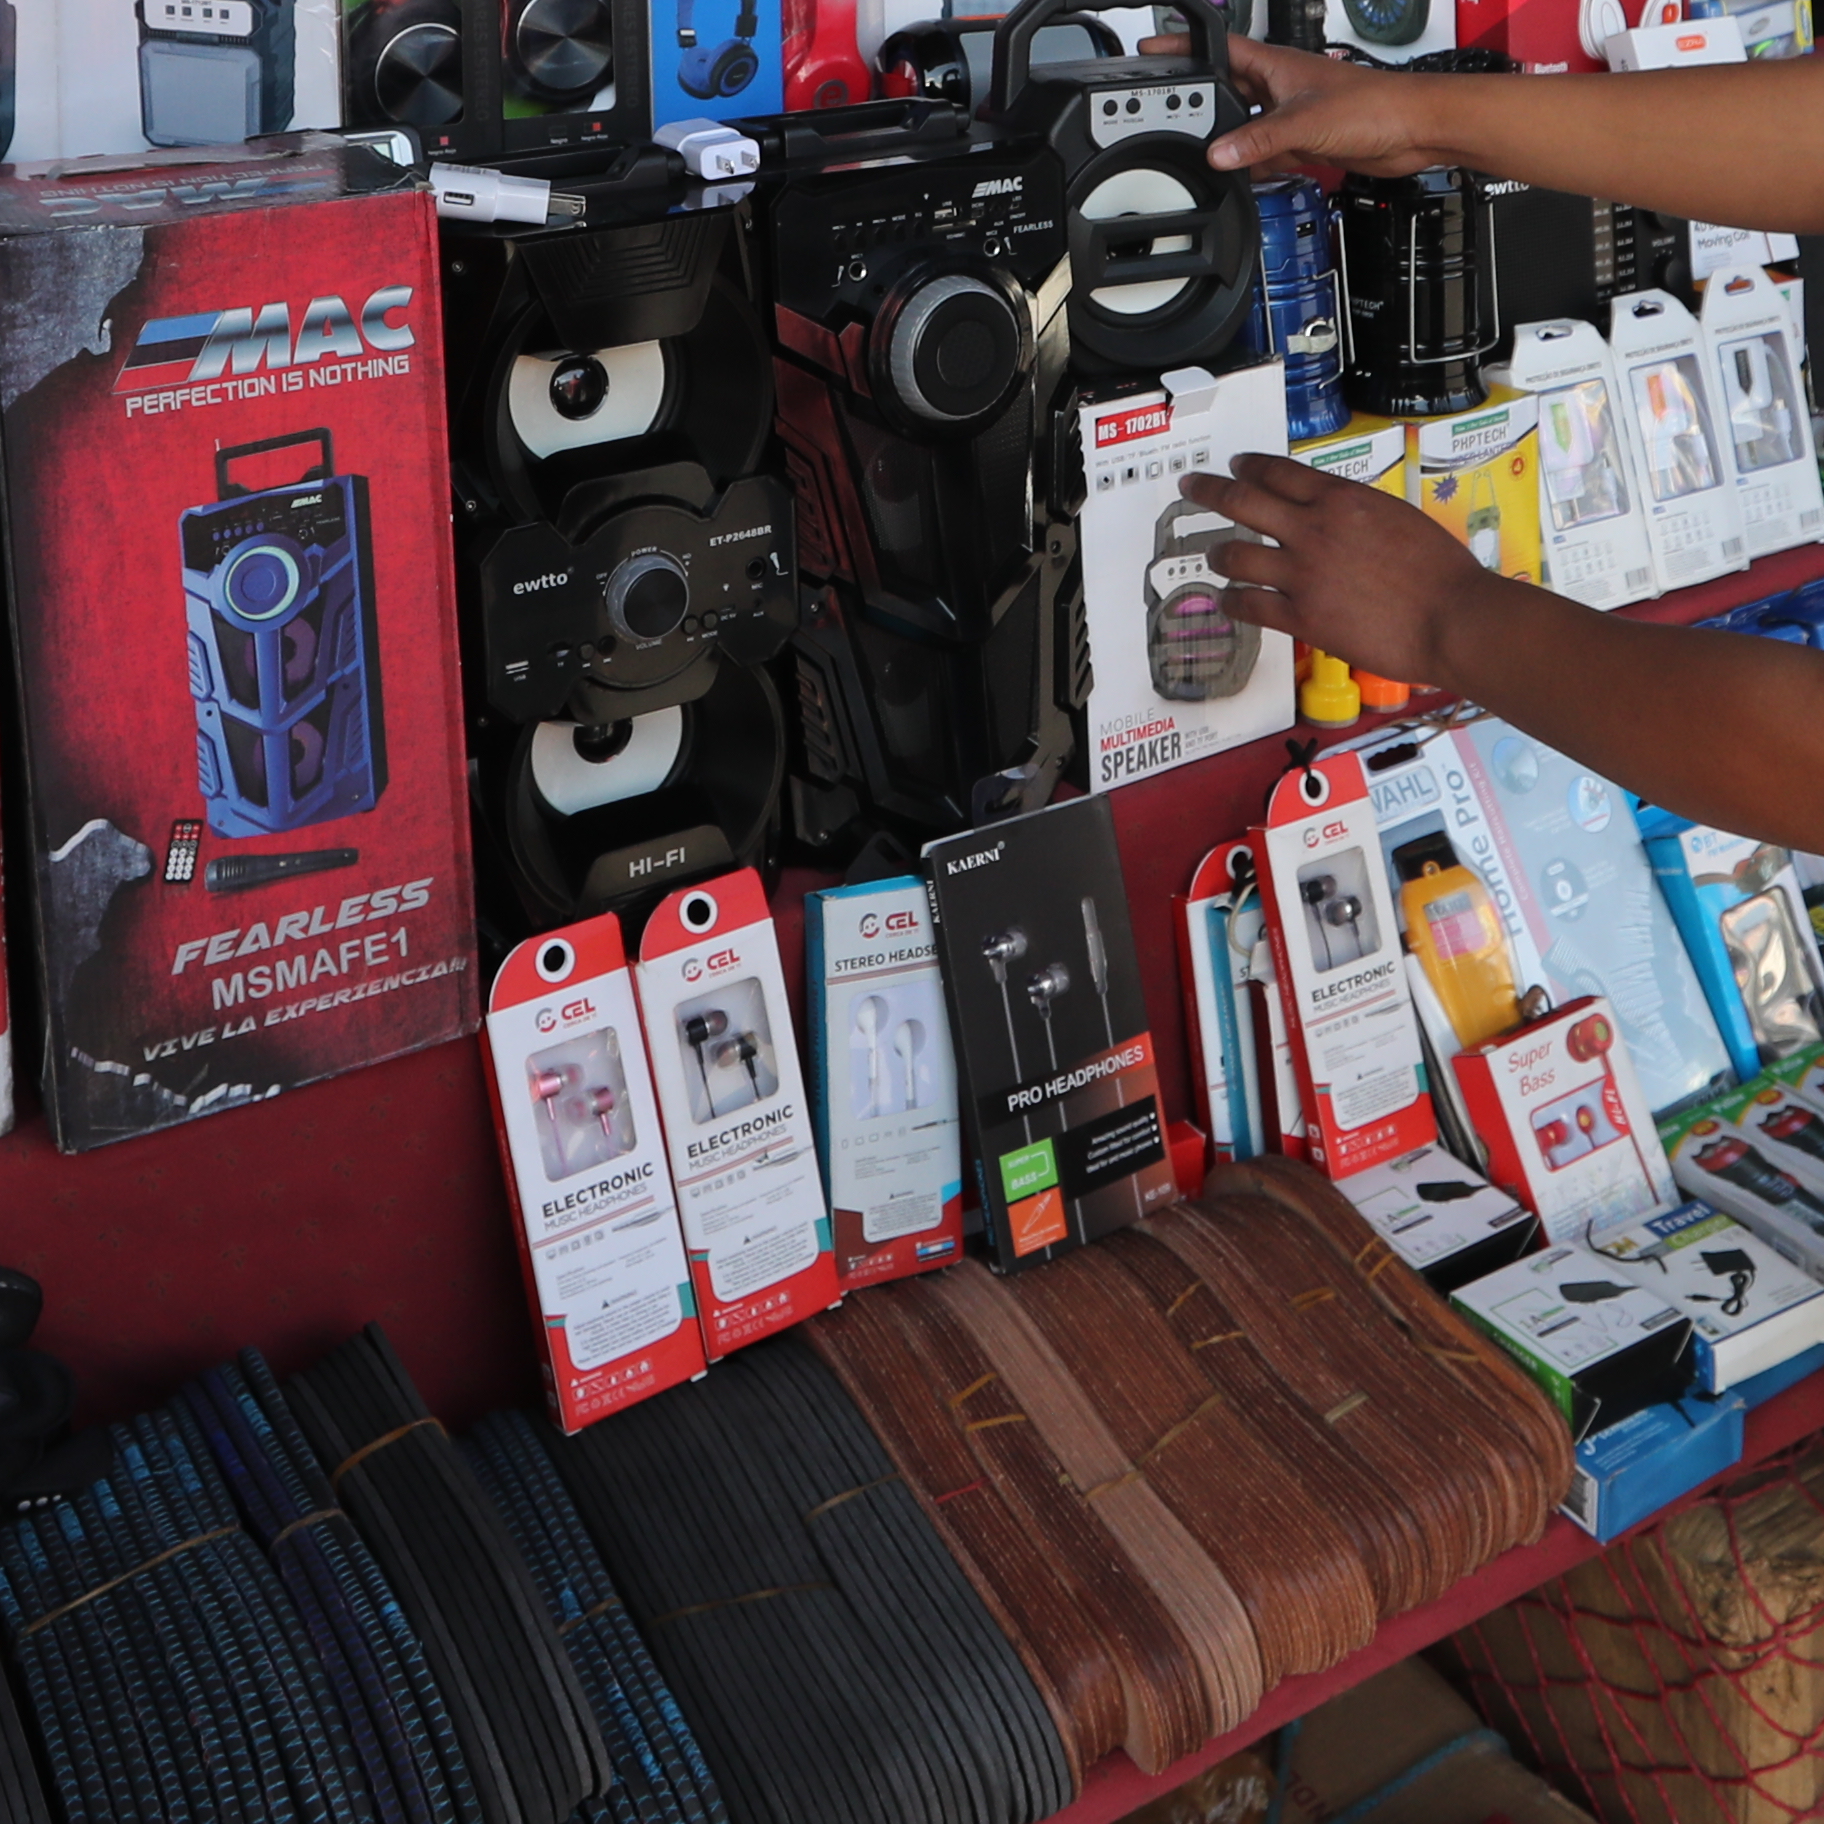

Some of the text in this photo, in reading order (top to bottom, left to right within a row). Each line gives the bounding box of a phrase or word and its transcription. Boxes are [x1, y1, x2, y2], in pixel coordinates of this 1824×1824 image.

[1131, 87, 1176, 96] MS-1701BT
[986, 176, 1023, 196] MAC
[1013, 220, 1053, 234] FEARLESS
[1697, 235, 1733, 249] Moving
[188, 285, 416, 382] MAC
[126, 354, 410, 418] PERFECTION IS NOTHING
[1098, 411, 1167, 441] MS-1702BT
[1452, 427, 1507, 452] PHPTECH
[709, 525, 772, 547] ET-P2648BR
[512, 572, 568, 595] ewtto
[1100, 708, 1155, 737] MOBILE
[1100, 717, 1175, 753] MULTIMEDIA
[1101, 732, 1181, 784] SPEAKER
[1446, 770, 1480, 829] Pro
[1322, 821, 1348, 838] CEL
[629, 847, 686, 878] HI-FI
[947, 848, 1000, 875] KAERNI
[926, 880, 940, 924] KAERNI
[171, 877, 434, 976] FEARLESS
[885, 911, 919, 930] CEL
[211, 926, 408, 1011] MSMAFE1
[706, 948, 740, 970] CEL
[834, 954, 884, 972] STEREO
[1312, 961, 1397, 1003] ELECTRONIC
[1341, 979, 1391, 1005] HEADPHONES
[561, 998, 596, 1019] CEL
[143, 1027, 216, 1062] VIVE
[221, 1016, 257, 1039] LA
[1508, 1041, 1552, 1073] Super
[1008, 1045, 1144, 1112] PRO HEADPHONES
[1519, 1069, 1556, 1097] Bass
[687, 1105, 794, 1158] ELECTRONIC
[688, 1124, 787, 1172] MUSIC HEADPHONES
[542, 1162, 655, 1218] ELECTRONIC
[544, 1182, 648, 1232] MUSIC HEADPHONES
[1654, 1203, 1711, 1235] Travel
